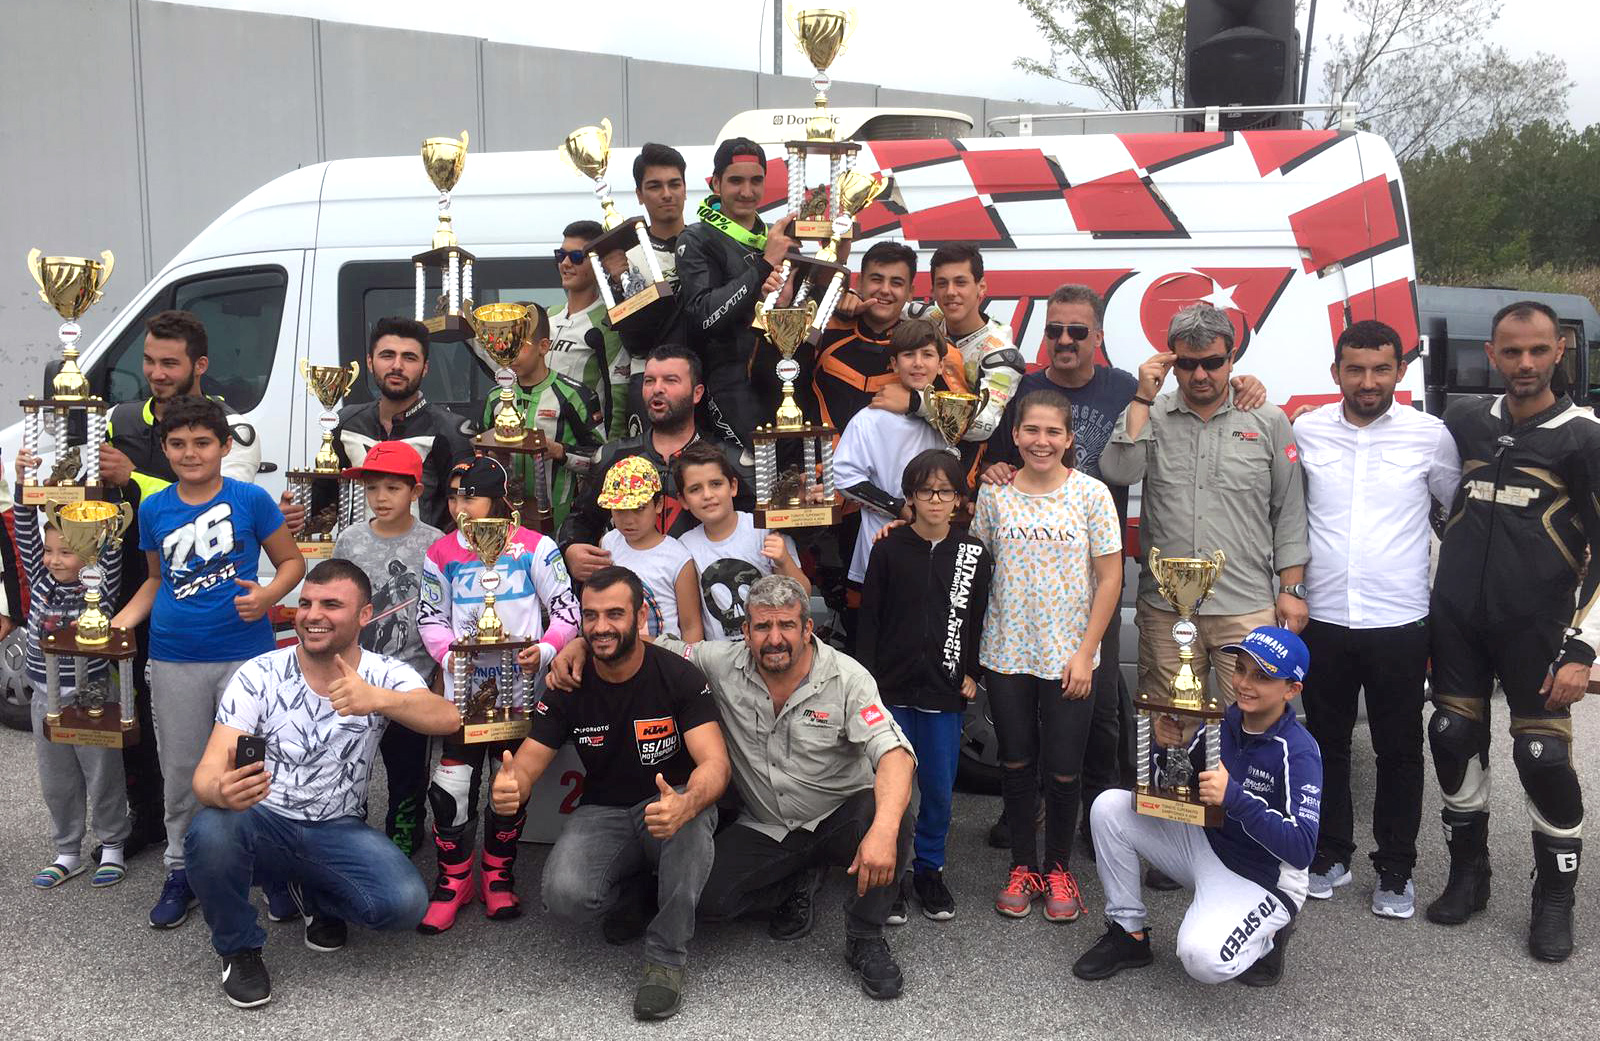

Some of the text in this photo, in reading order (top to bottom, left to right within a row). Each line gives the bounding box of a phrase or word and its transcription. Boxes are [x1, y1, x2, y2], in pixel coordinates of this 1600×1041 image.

[787, 114, 841, 125] Doic
[697, 205, 732, 231] 100%
[1071, 404, 1113, 433] NGELE
[162, 502, 235, 571] 76
[452, 563, 527, 599] KTM
[949, 542, 967, 607] CRIME FIGHTIN
[958, 543, 983, 610] BATMAN
[1254, 632, 1290, 659] YAMAHA
[642, 735, 677, 754] SS/100
[643, 725, 669, 736] KTM
[559, 770, 585, 814] 2
[1556, 852, 1578, 873] G
[1219, 895, 1277, 963] TO SPEED
